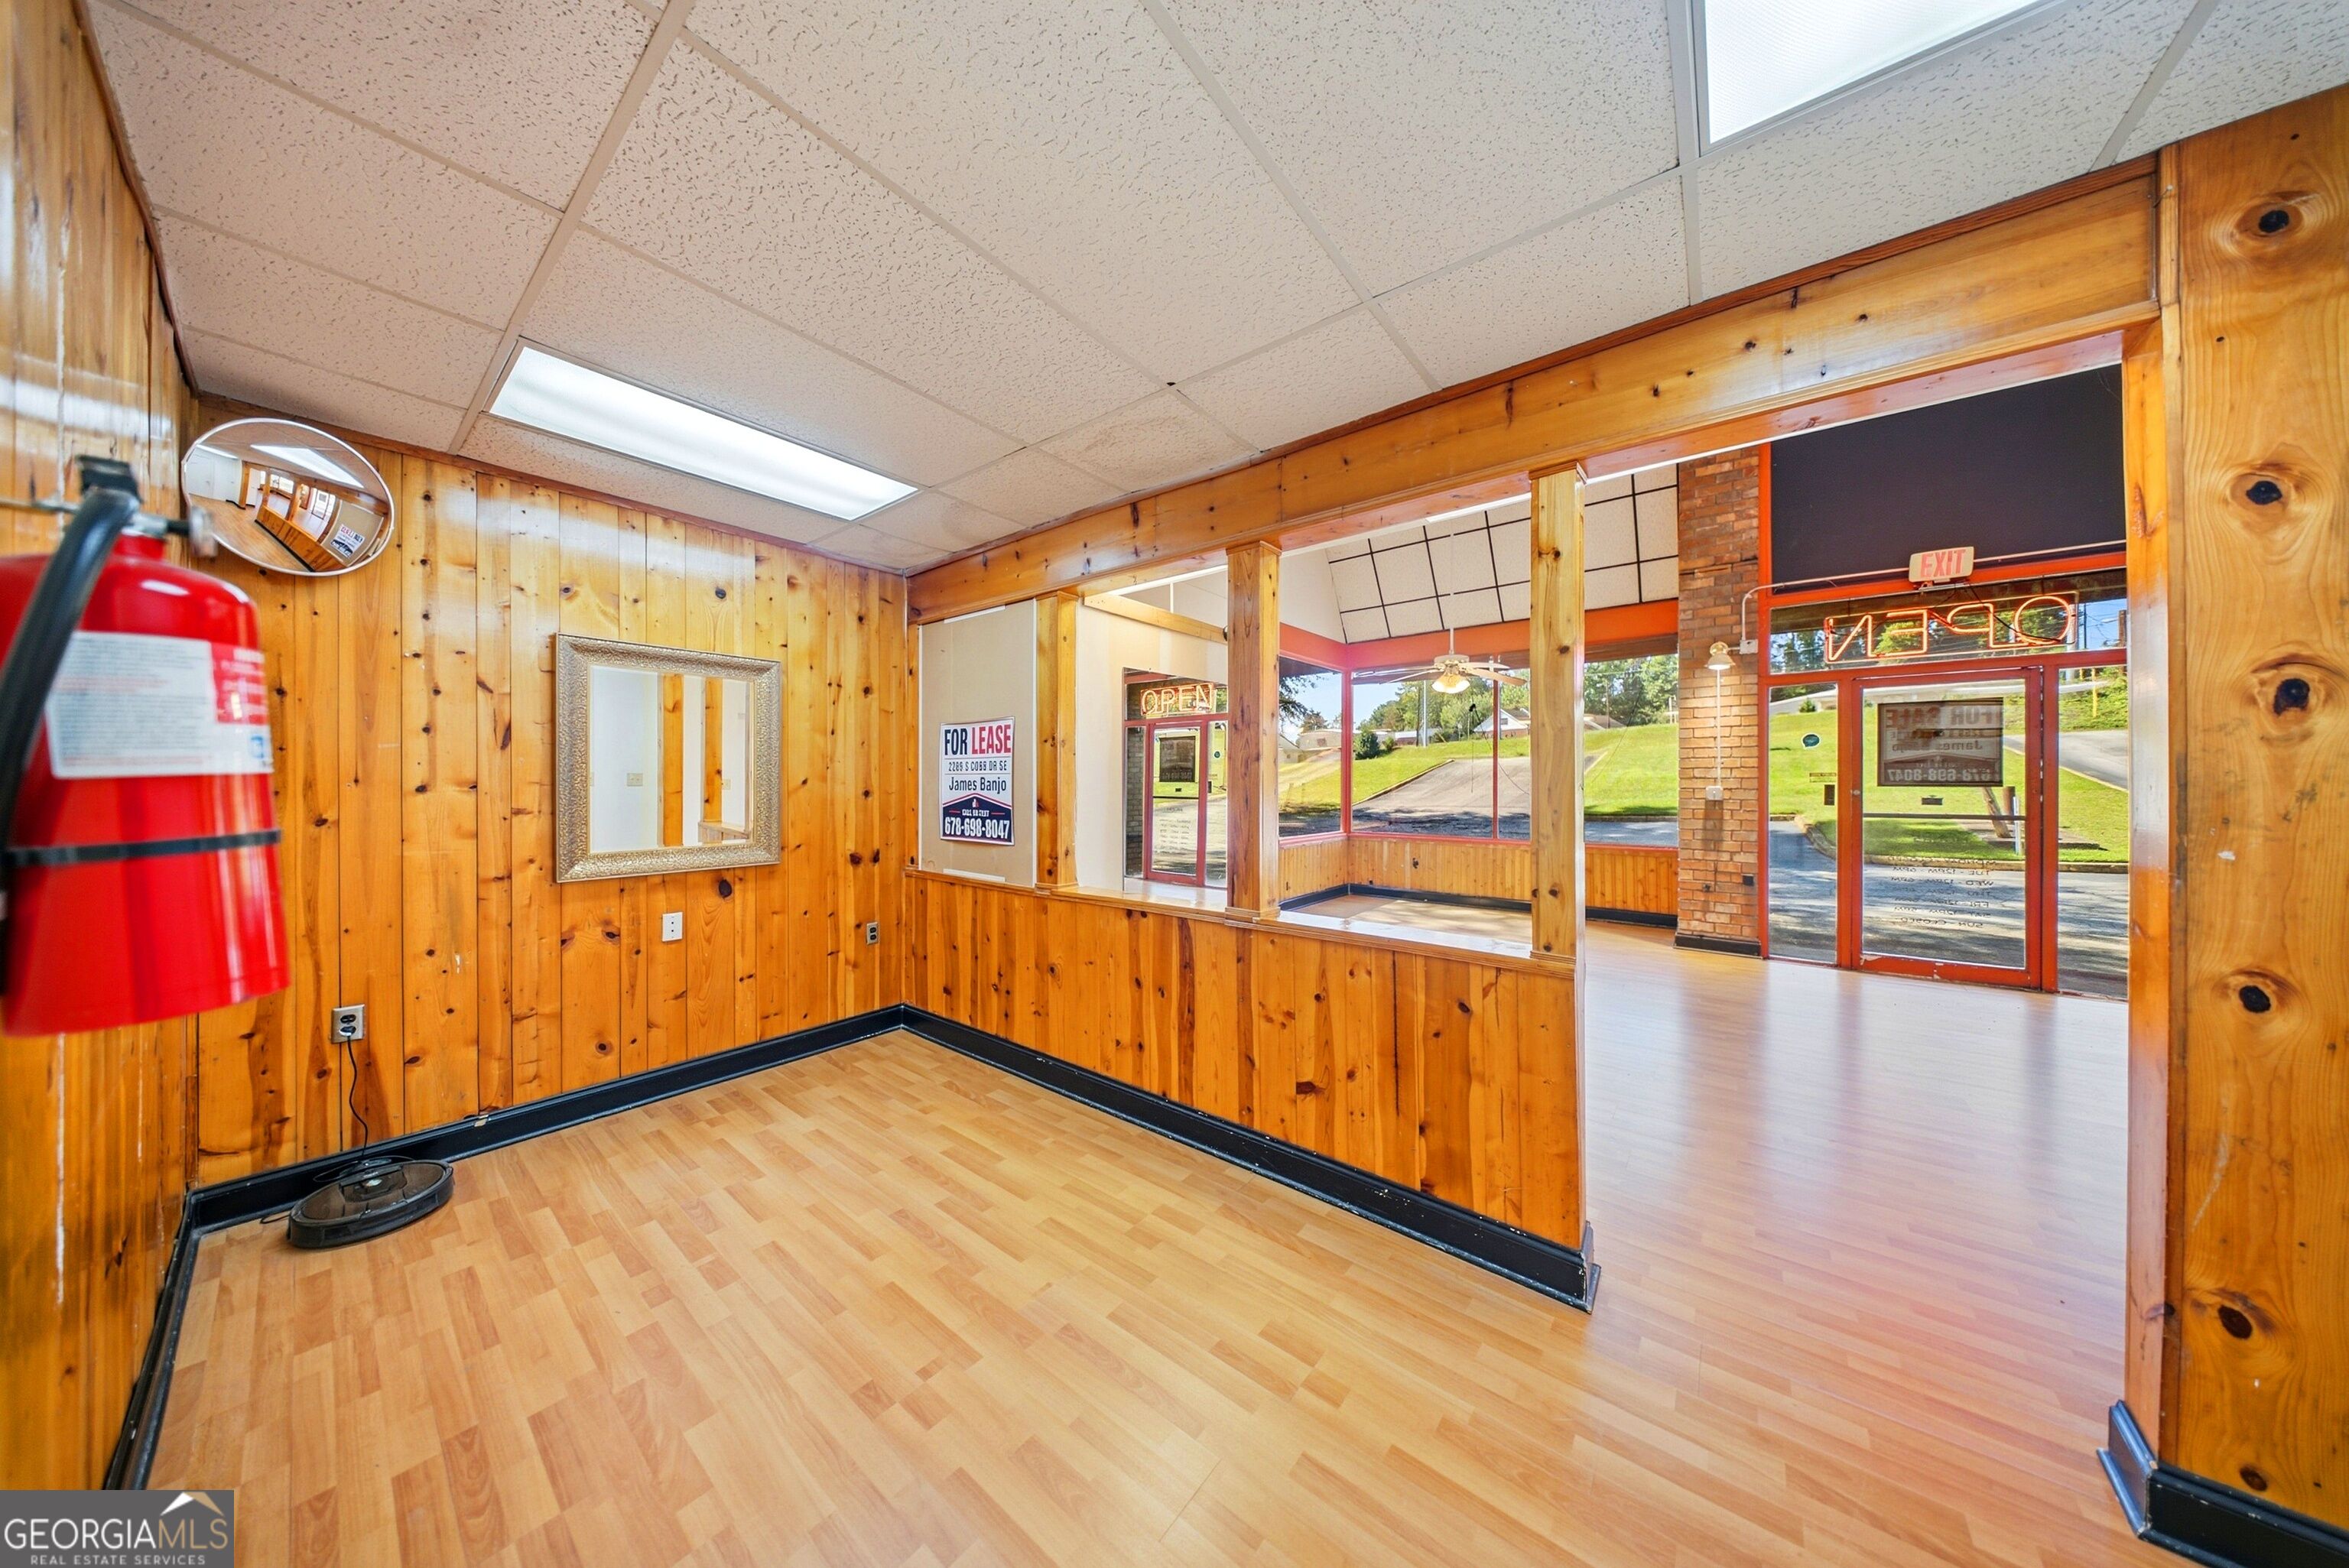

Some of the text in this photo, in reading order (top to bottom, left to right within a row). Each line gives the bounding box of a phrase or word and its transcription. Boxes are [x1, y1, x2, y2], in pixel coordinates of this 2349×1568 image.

[1920, 550, 1966, 578] EXIT
[1142, 683, 1213, 715] OPEN
[944, 724, 1012, 756] FOR LEASE
[965, 761, 970, 771] S
[999, 761, 1007, 771] SE
[949, 777, 1006, 794] James Banjo
[944, 816, 1010, 839] 678-698-8047
